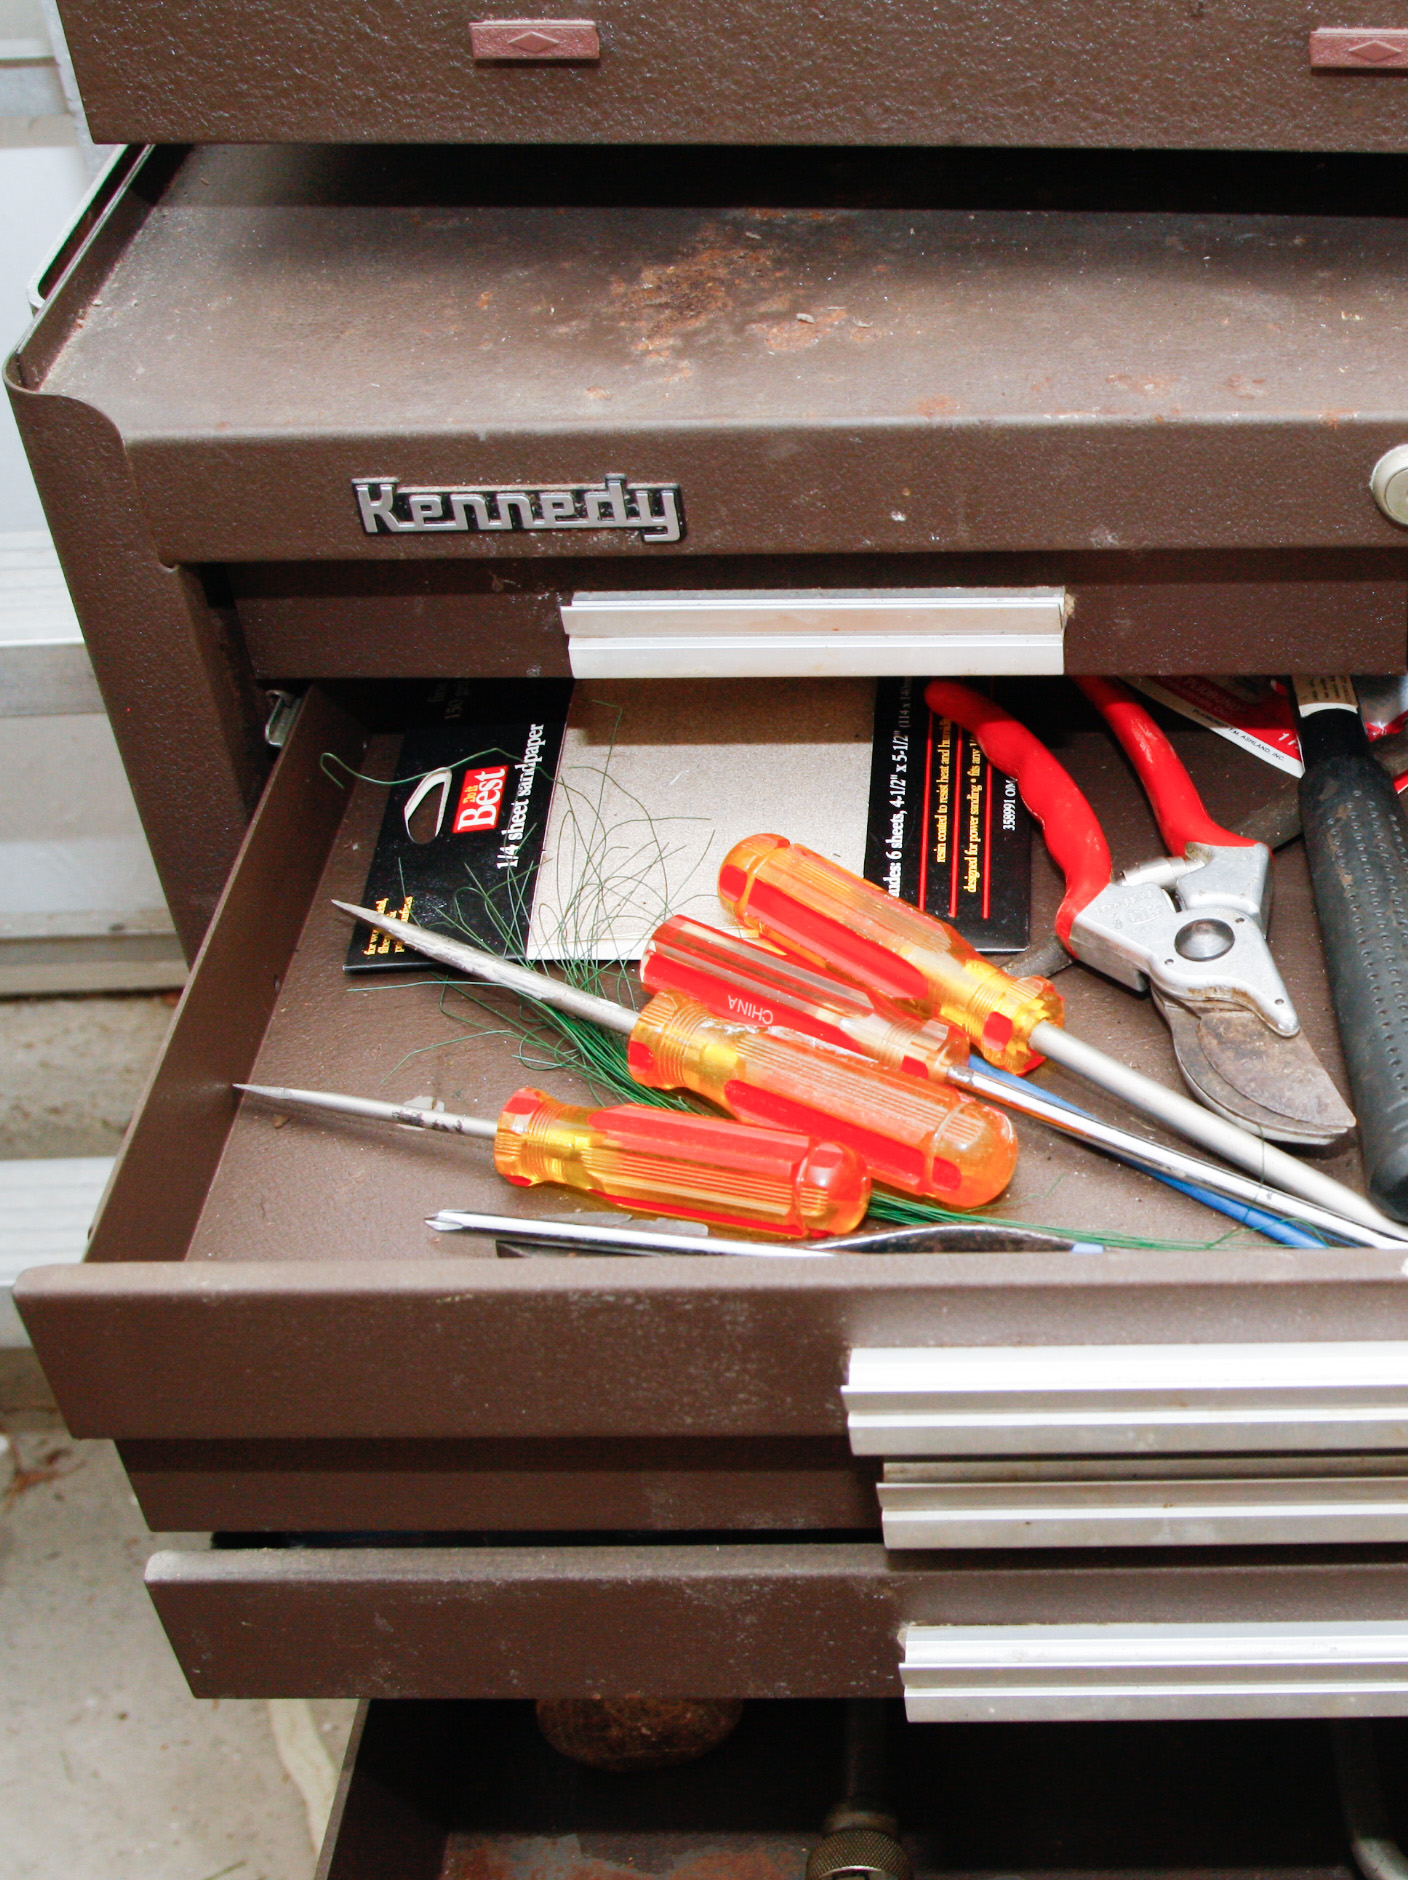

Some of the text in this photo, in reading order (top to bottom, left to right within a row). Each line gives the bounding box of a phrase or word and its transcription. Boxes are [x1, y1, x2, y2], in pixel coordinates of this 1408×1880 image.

[354, 475, 683, 542] Kennedy
[895, 762, 907, 773] x
[937, 748, 950, 765] and
[936, 763, 950, 784] heat
[457, 768, 506, 831] Best
[497, 724, 546, 869] 1/4 sheet sandpaper
[935, 784, 949, 805] resist
[966, 784, 982, 815] sanding
[936, 804, 948, 815] to
[1002, 799, 1016, 831] 358991
[885, 812, 908, 849] sheets,
[934, 814, 948, 843] coated
[968, 815, 981, 843] power
[885, 851, 902, 860] 6
[934, 842, 947, 862] resin
[964, 842, 979, 856] for
[963, 856, 981, 893] designed
[727, 994, 775, 1025] CHINA
